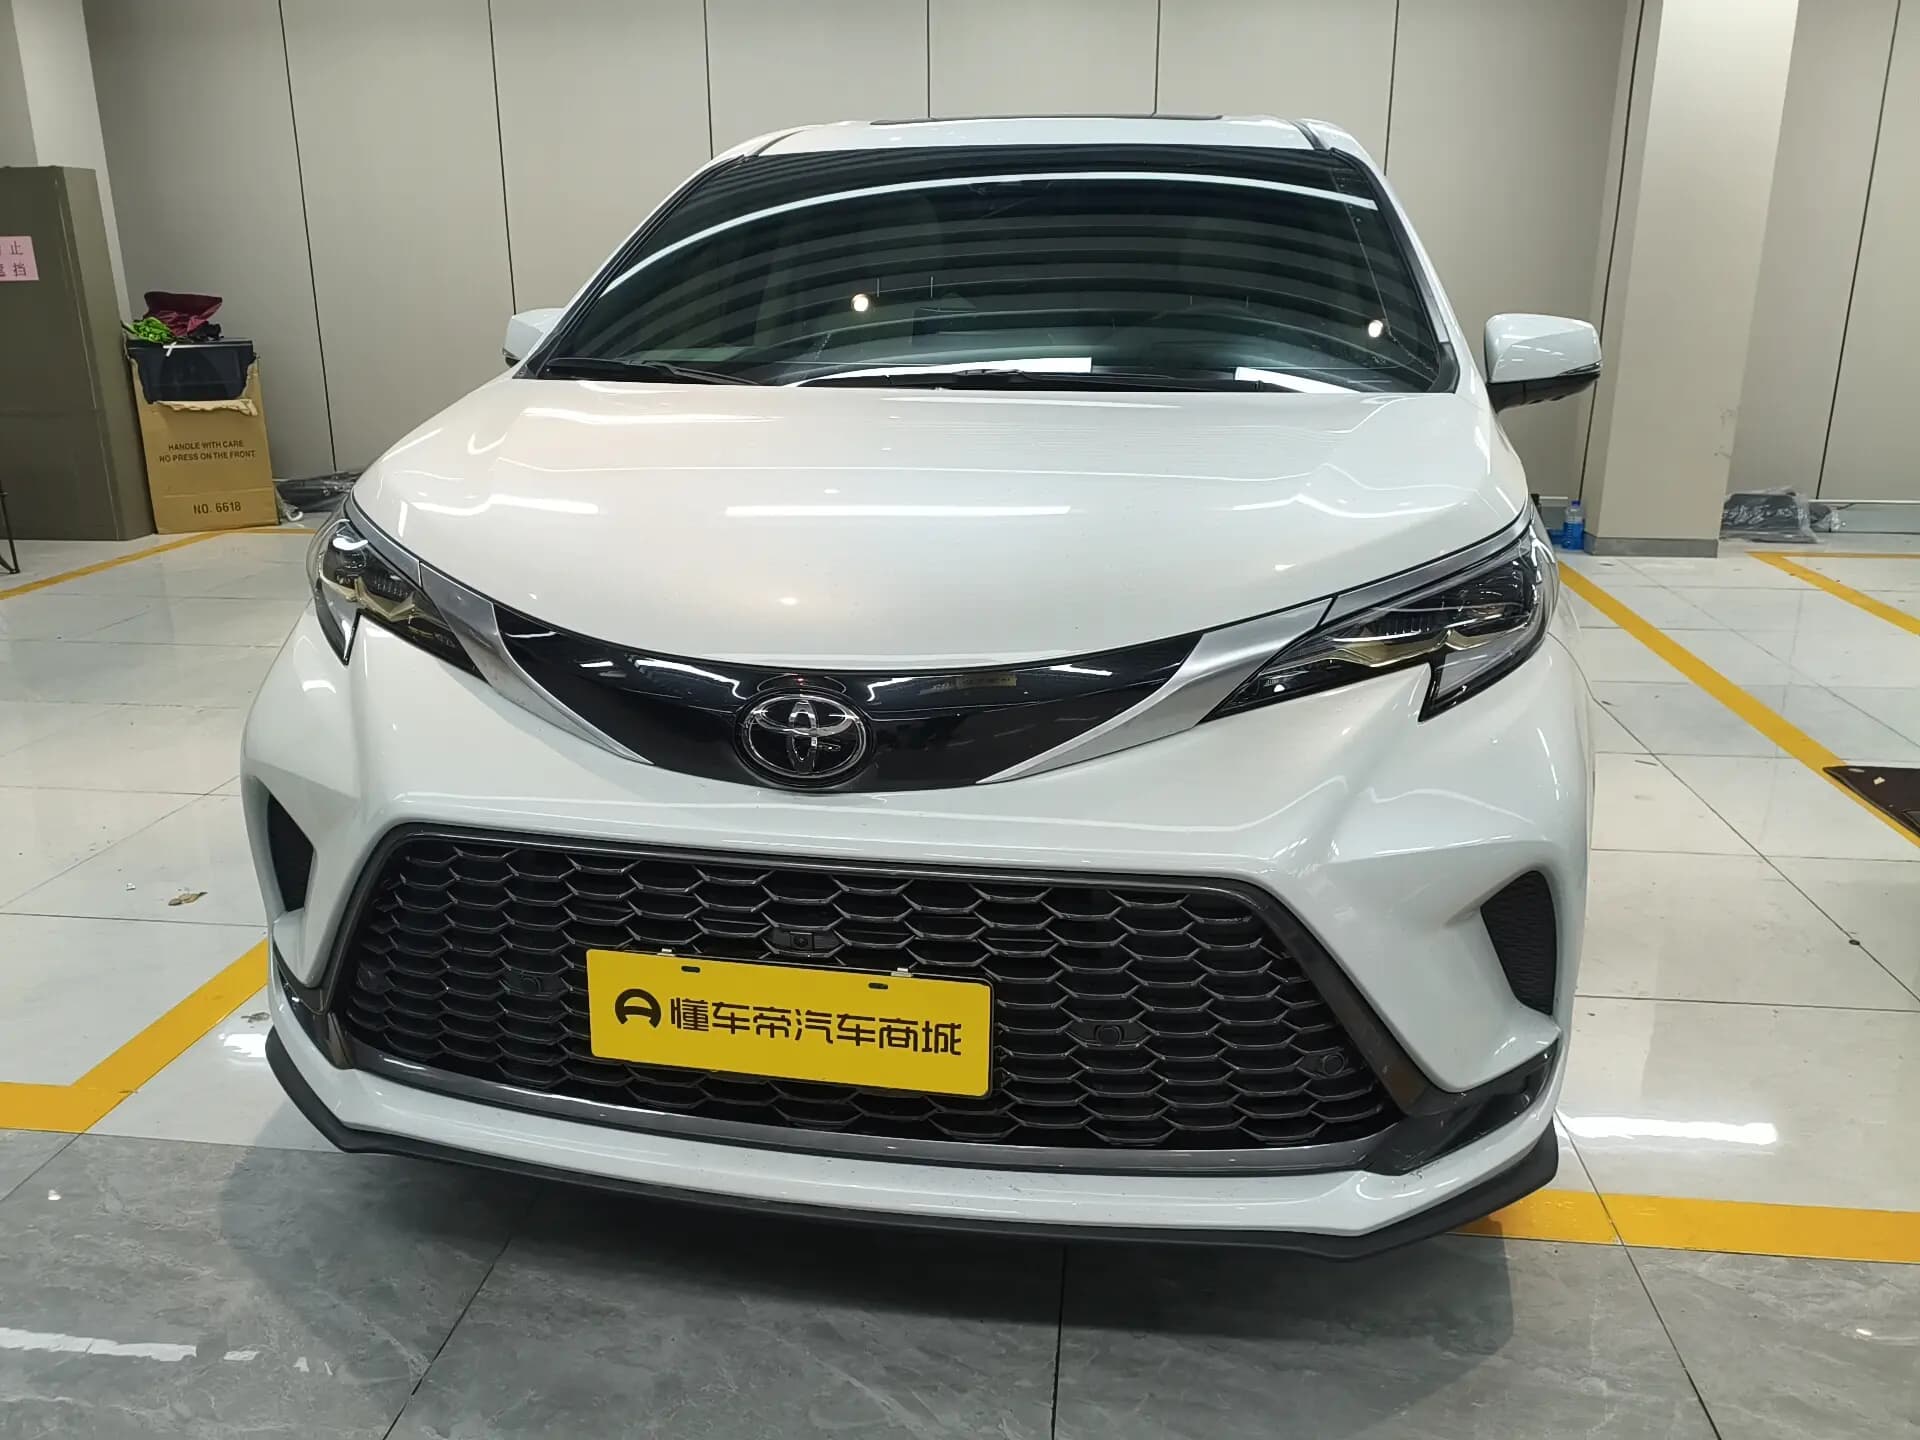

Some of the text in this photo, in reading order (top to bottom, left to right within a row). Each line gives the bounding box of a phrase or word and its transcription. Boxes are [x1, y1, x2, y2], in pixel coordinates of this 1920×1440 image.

[168, 440, 244, 451] HANDLE WITH CARE
[159, 450, 256, 463] NO PRESS ON THE FRONT
[193, 501, 242, 514] NO. 6618
[670, 997, 962, 1056] 懂车帝汽车商城
